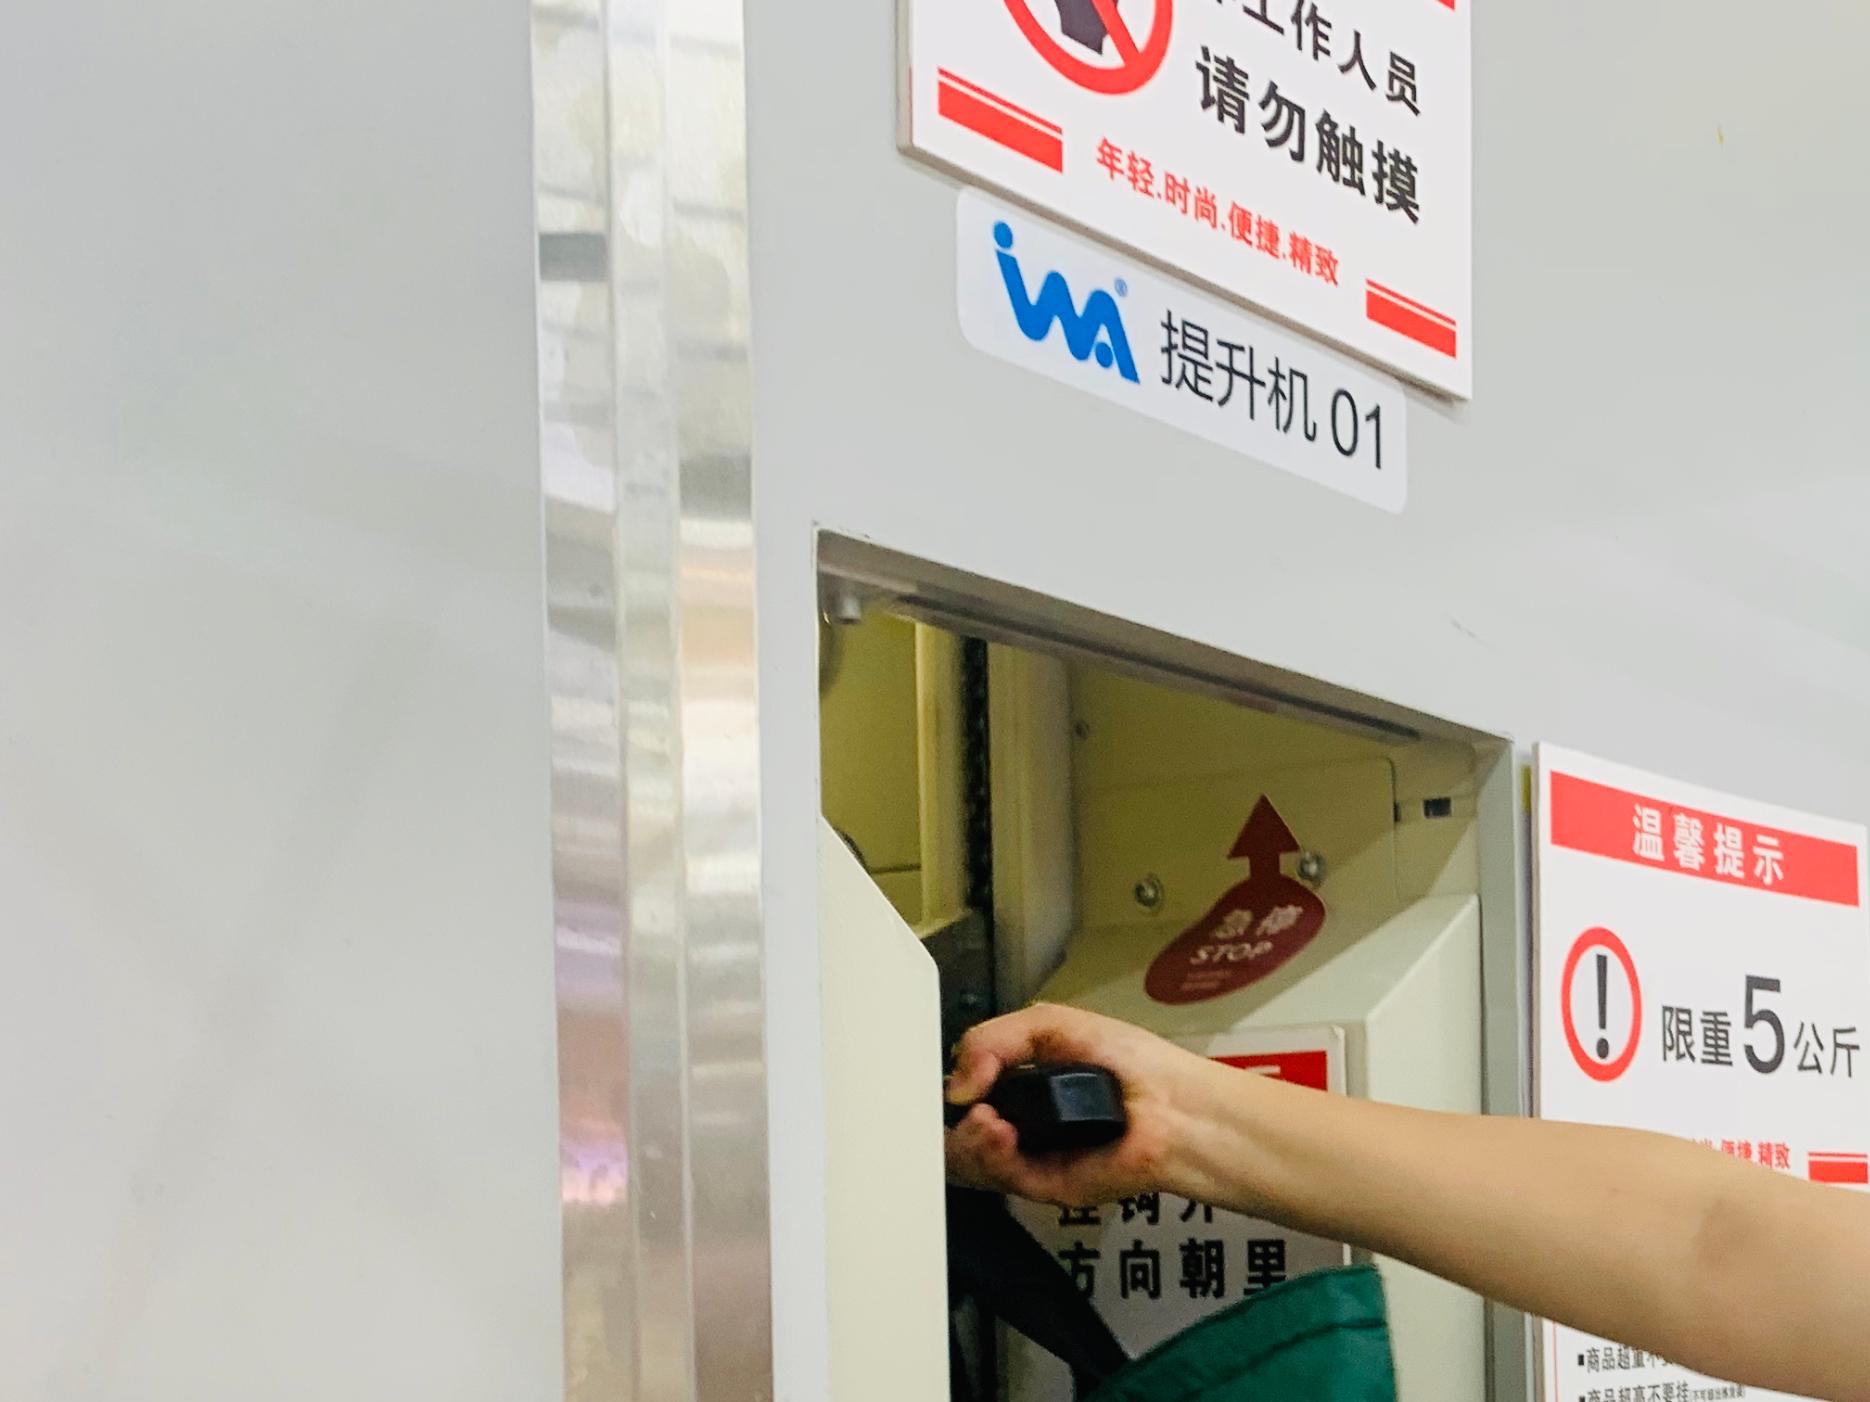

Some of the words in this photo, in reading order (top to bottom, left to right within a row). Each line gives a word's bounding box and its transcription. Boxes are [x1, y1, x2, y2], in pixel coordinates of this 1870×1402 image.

[1215, 0, 1420, 117] 工作人员
[1195, 45, 1419, 225] 请勿触摸
[1160, 310, 1317, 443] 提升机
[1331, 388, 1382, 470] 01
[1632, 803, 1785, 885] 温馨提示
[1190, 941, 1273, 965] STOP
[1661, 974, 1861, 1078] 限重5公斤
[1058, 1238, 1288, 1299] 方向朝里
